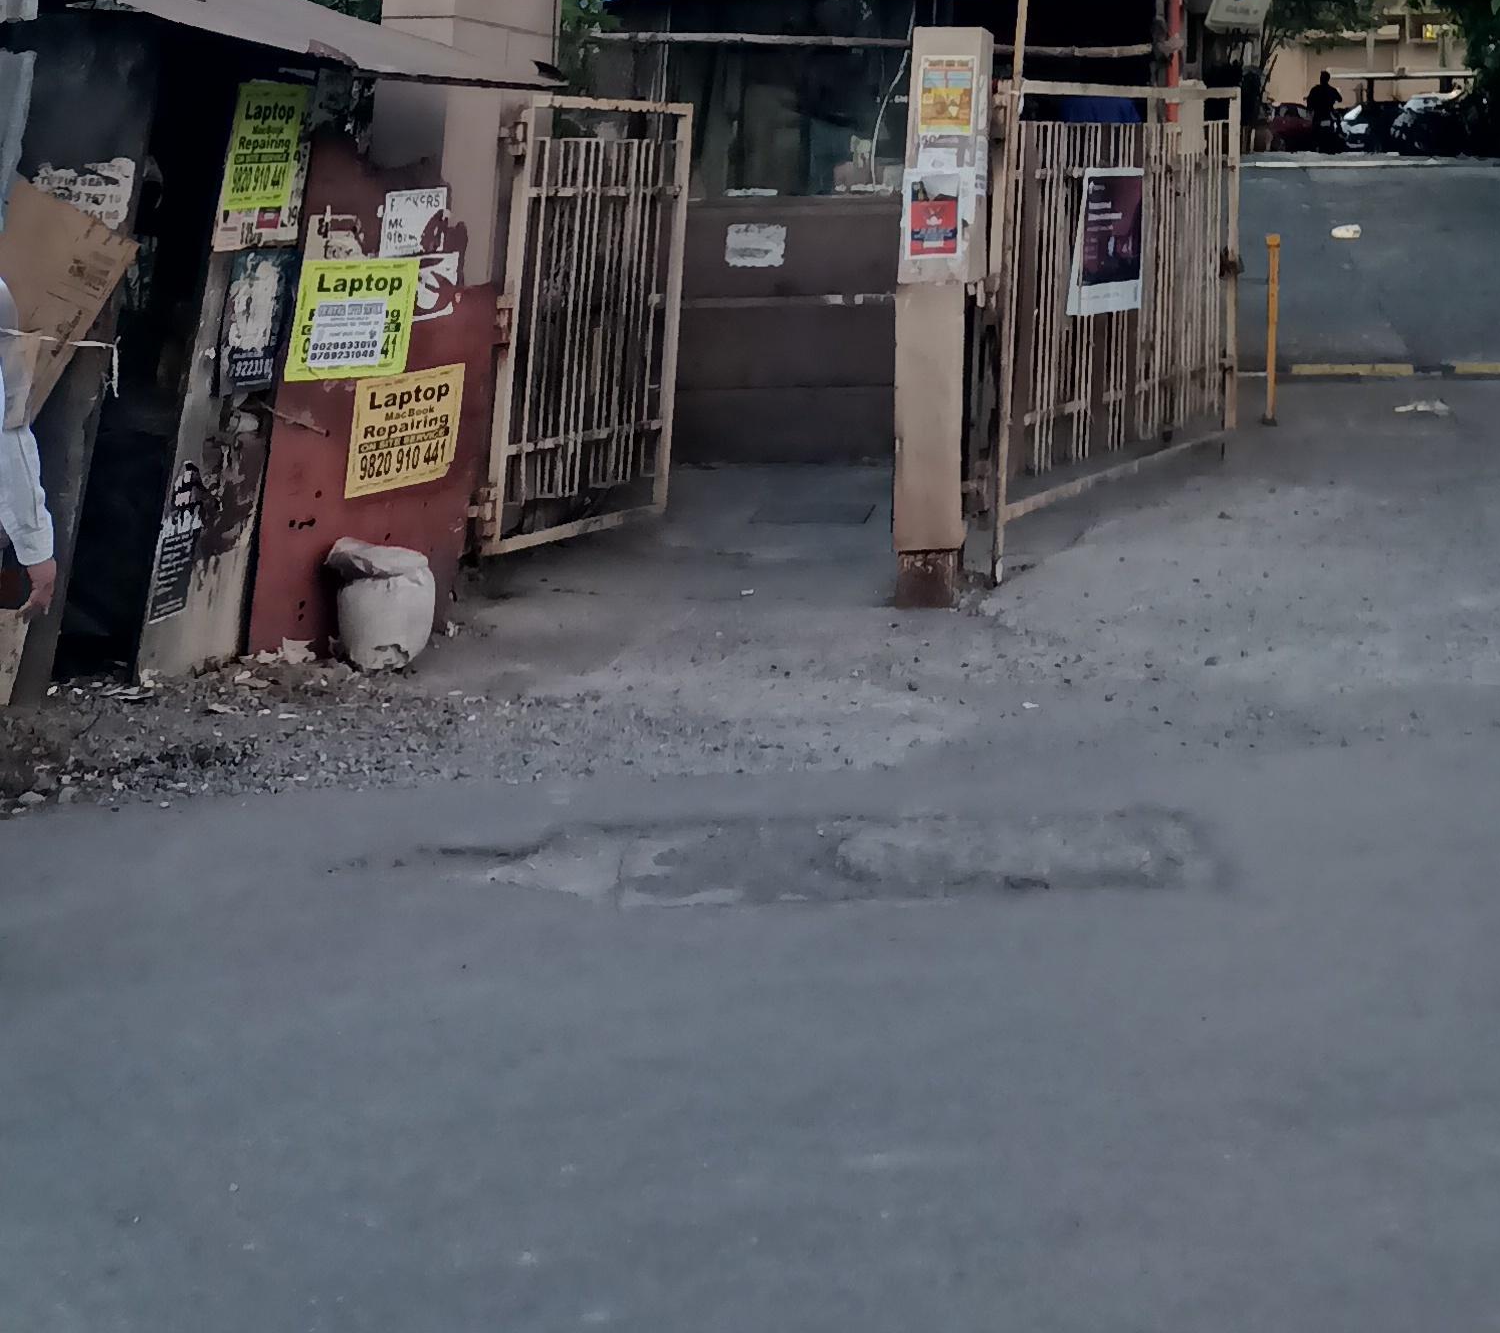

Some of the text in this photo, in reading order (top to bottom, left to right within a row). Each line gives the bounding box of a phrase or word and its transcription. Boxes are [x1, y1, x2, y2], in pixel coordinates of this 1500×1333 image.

[245, 100, 295, 125] Laptop
[238, 136, 291, 154] Repairing
[317, 273, 403, 297] Laptop
[369, 382, 450, 410] Laptop
[384, 405, 435, 421] MacBook
[363, 414, 449, 439] Repairing
[360, 438, 447, 481] 9820 910 441
